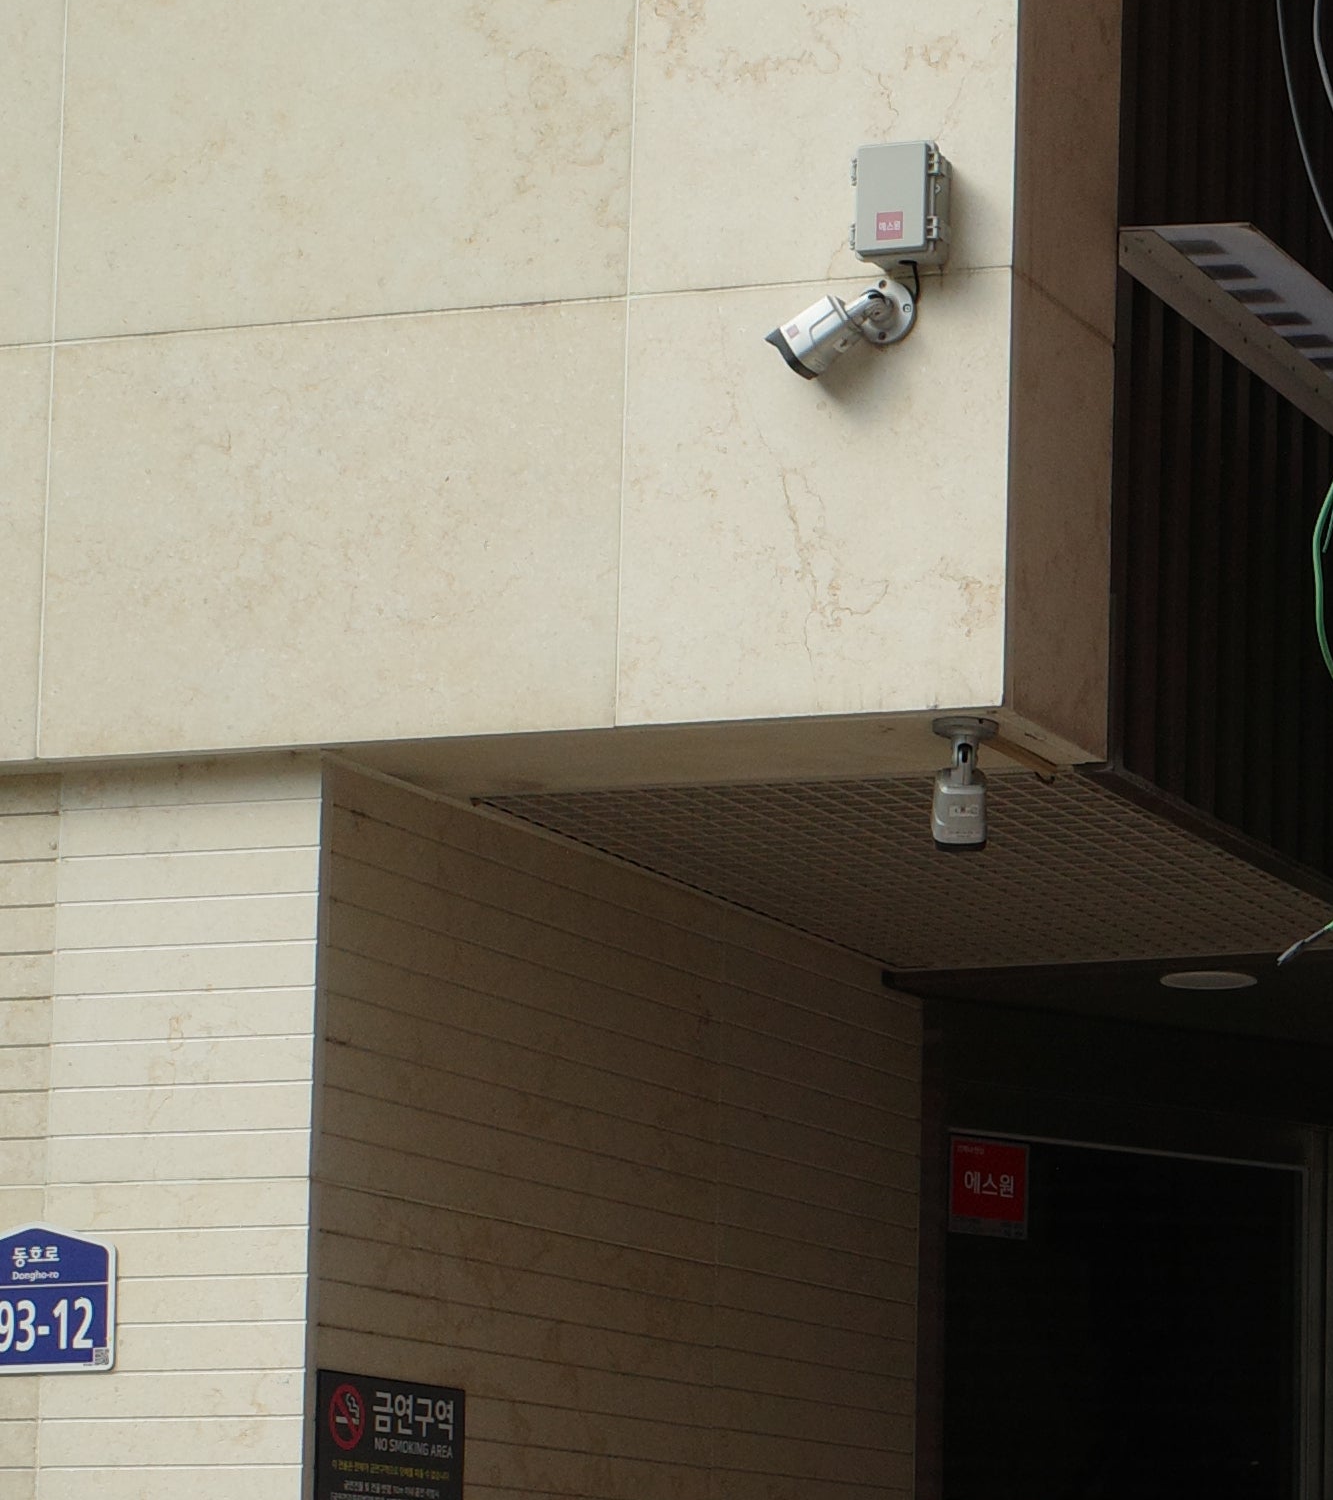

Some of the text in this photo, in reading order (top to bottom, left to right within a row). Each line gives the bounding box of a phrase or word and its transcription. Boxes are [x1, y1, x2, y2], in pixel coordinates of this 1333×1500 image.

[964, 1170, 1014, 1198] 에스원
[12, 1246, 60, 1268] 동호로
[12, 1270, 60, 1282] Dongho-ro
[0, 1297, 93, 1352] 93-12
[372, 1391, 455, 1441] 금연구역
[374, 1437, 453, 1459] NO SMOKING AREA
